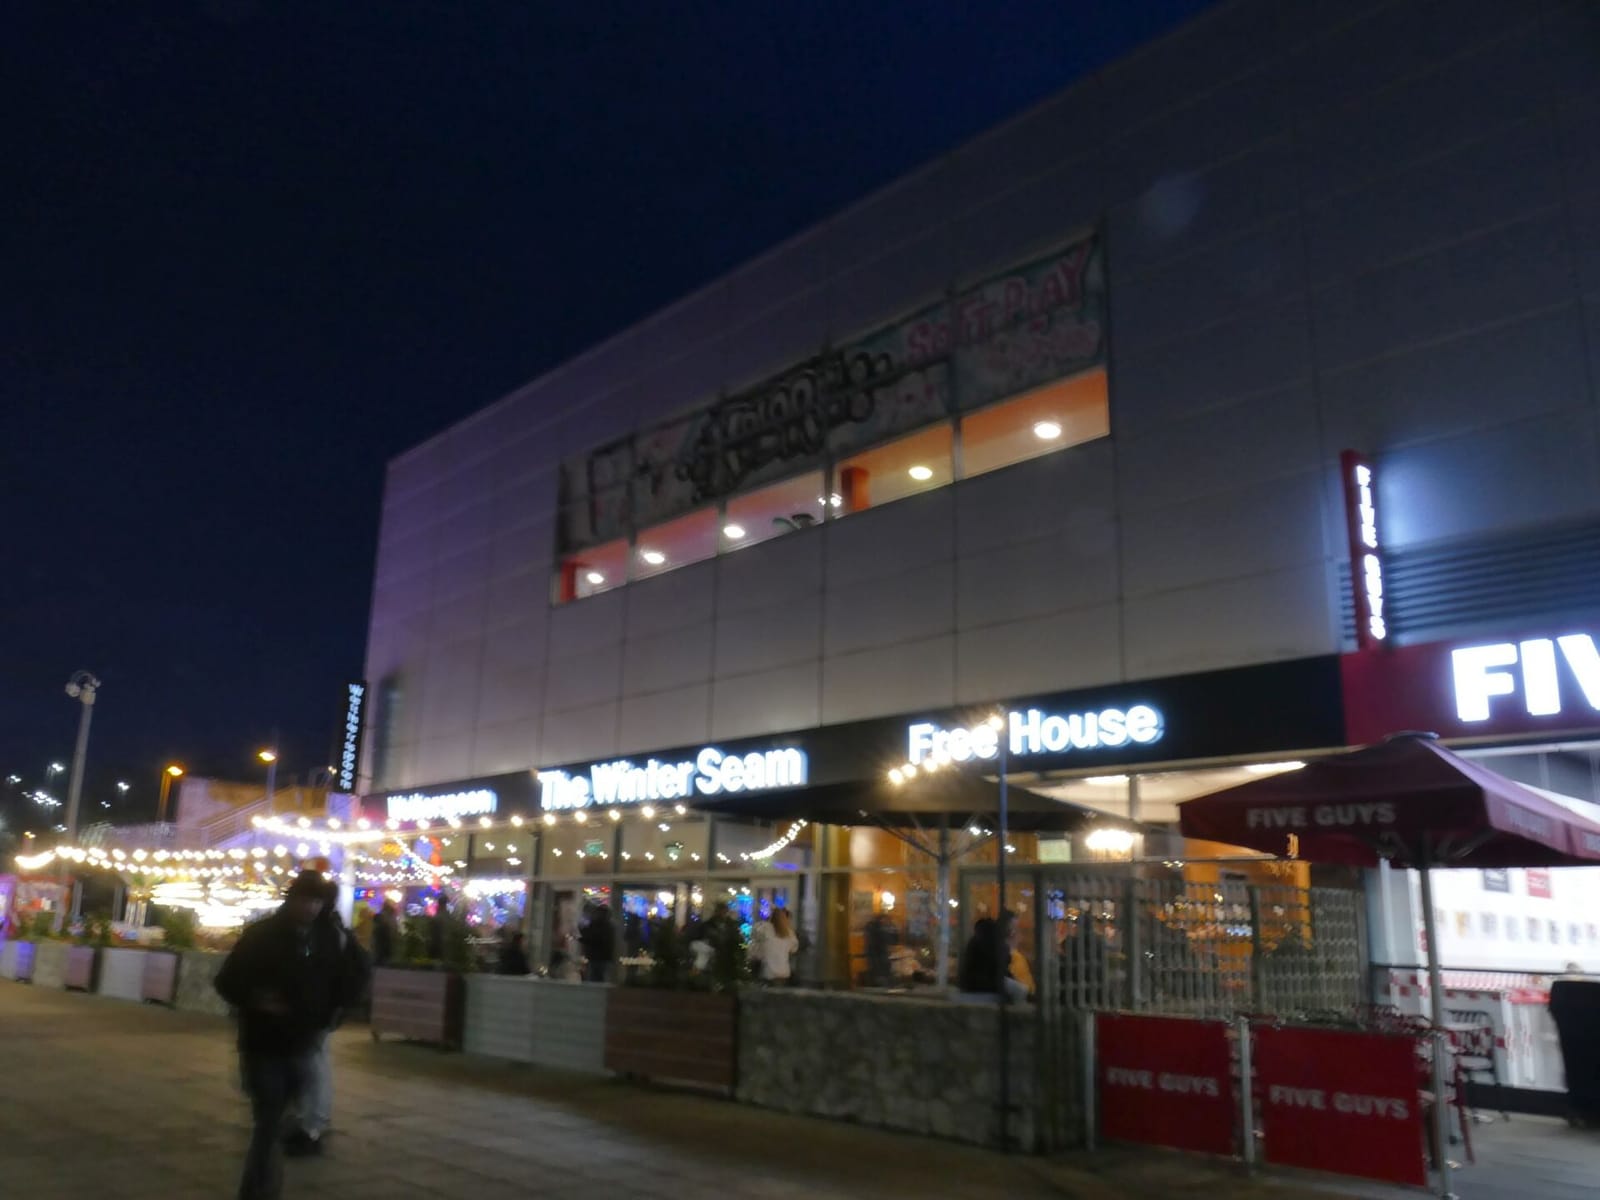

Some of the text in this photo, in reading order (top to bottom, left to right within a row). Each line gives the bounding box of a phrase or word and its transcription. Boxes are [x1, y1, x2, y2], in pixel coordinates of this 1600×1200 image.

[1357, 465, 1386, 639] FIVE GUYS
[908, 705, 1163, 765] Free House
[538, 747, 808, 811] The Winter Seam
[1247, 802, 1397, 829] FIVE GUYS
[1105, 1067, 1220, 1099] FIVE GUYS
[1269, 1084, 1410, 1120] FIVE GUYS
